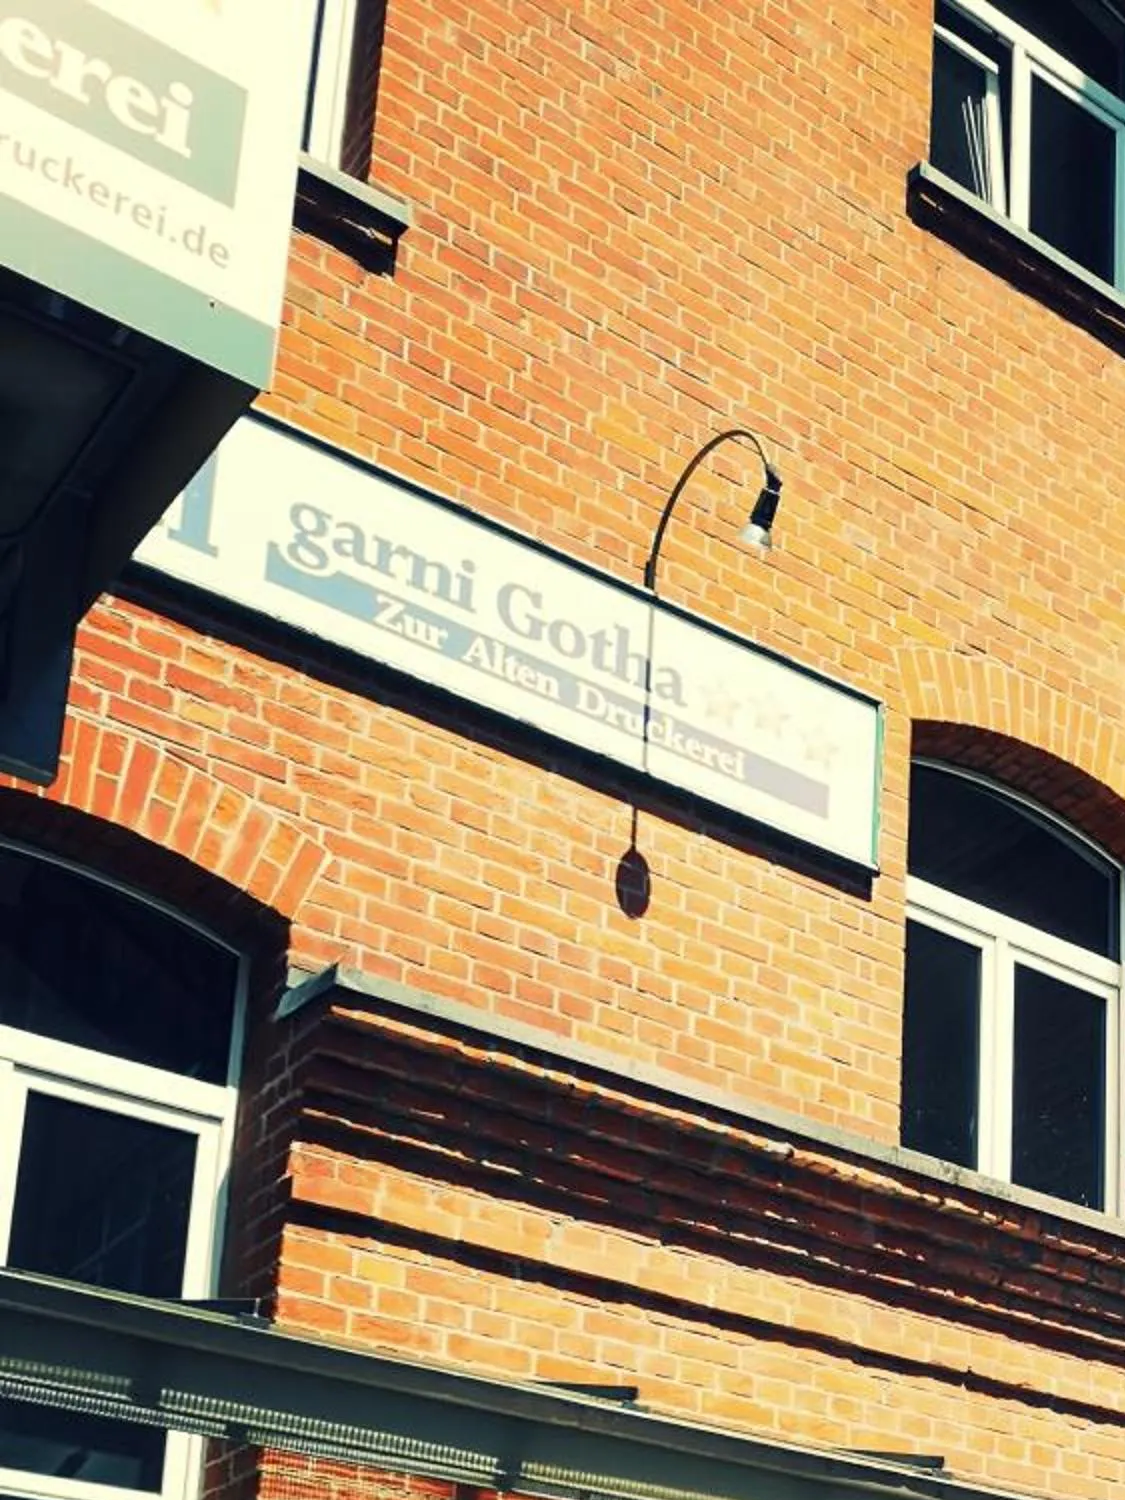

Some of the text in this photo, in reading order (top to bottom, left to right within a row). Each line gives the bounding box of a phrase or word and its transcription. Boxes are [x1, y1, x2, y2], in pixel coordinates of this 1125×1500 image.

[284, 502, 477, 612] garni
[497, 582, 688, 707] Gotha
[373, 595, 747, 780] Zur Alten Druckerei
